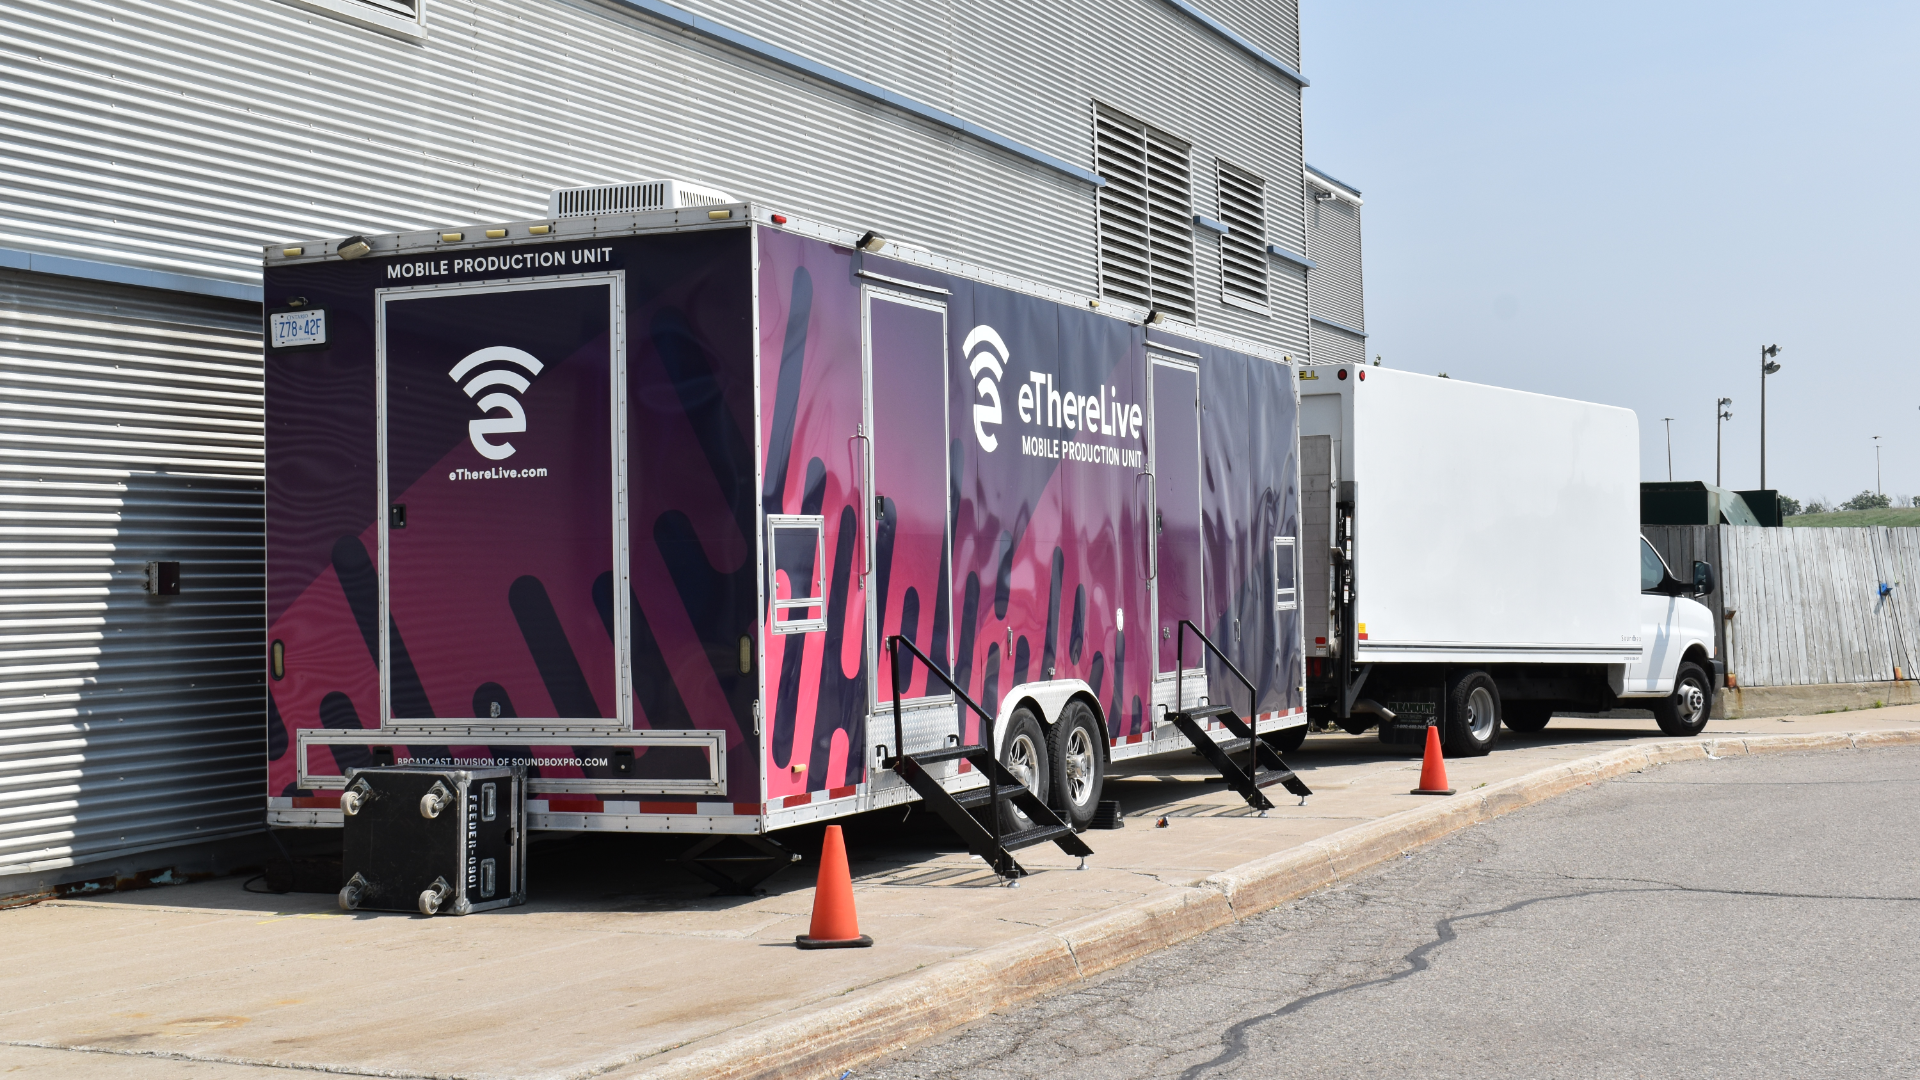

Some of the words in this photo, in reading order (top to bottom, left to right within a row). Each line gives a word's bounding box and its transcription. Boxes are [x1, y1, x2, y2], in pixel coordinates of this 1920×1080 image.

[387, 260, 449, 279] MOBILE
[454, 251, 566, 274] PRODUCTION
[571, 247, 613, 265] UNIT
[279, 320, 298, 338] Z78
[304, 318, 322, 336] 42F
[1018, 371, 1142, 439] eThereLive
[1022, 435, 1059, 459] MOBILE
[1062, 440, 1119, 466] PRODUCTION
[1122, 448, 1142, 468] UNIT
[449, 467, 548, 481] eThereLive.com
[454, 757, 494, 767] DIVISION
[496, 757, 509, 767] OF
[512, 757, 608, 767] SOUNDBOXPRO.COM
[468, 794, 478, 889] FEEDER-0901
